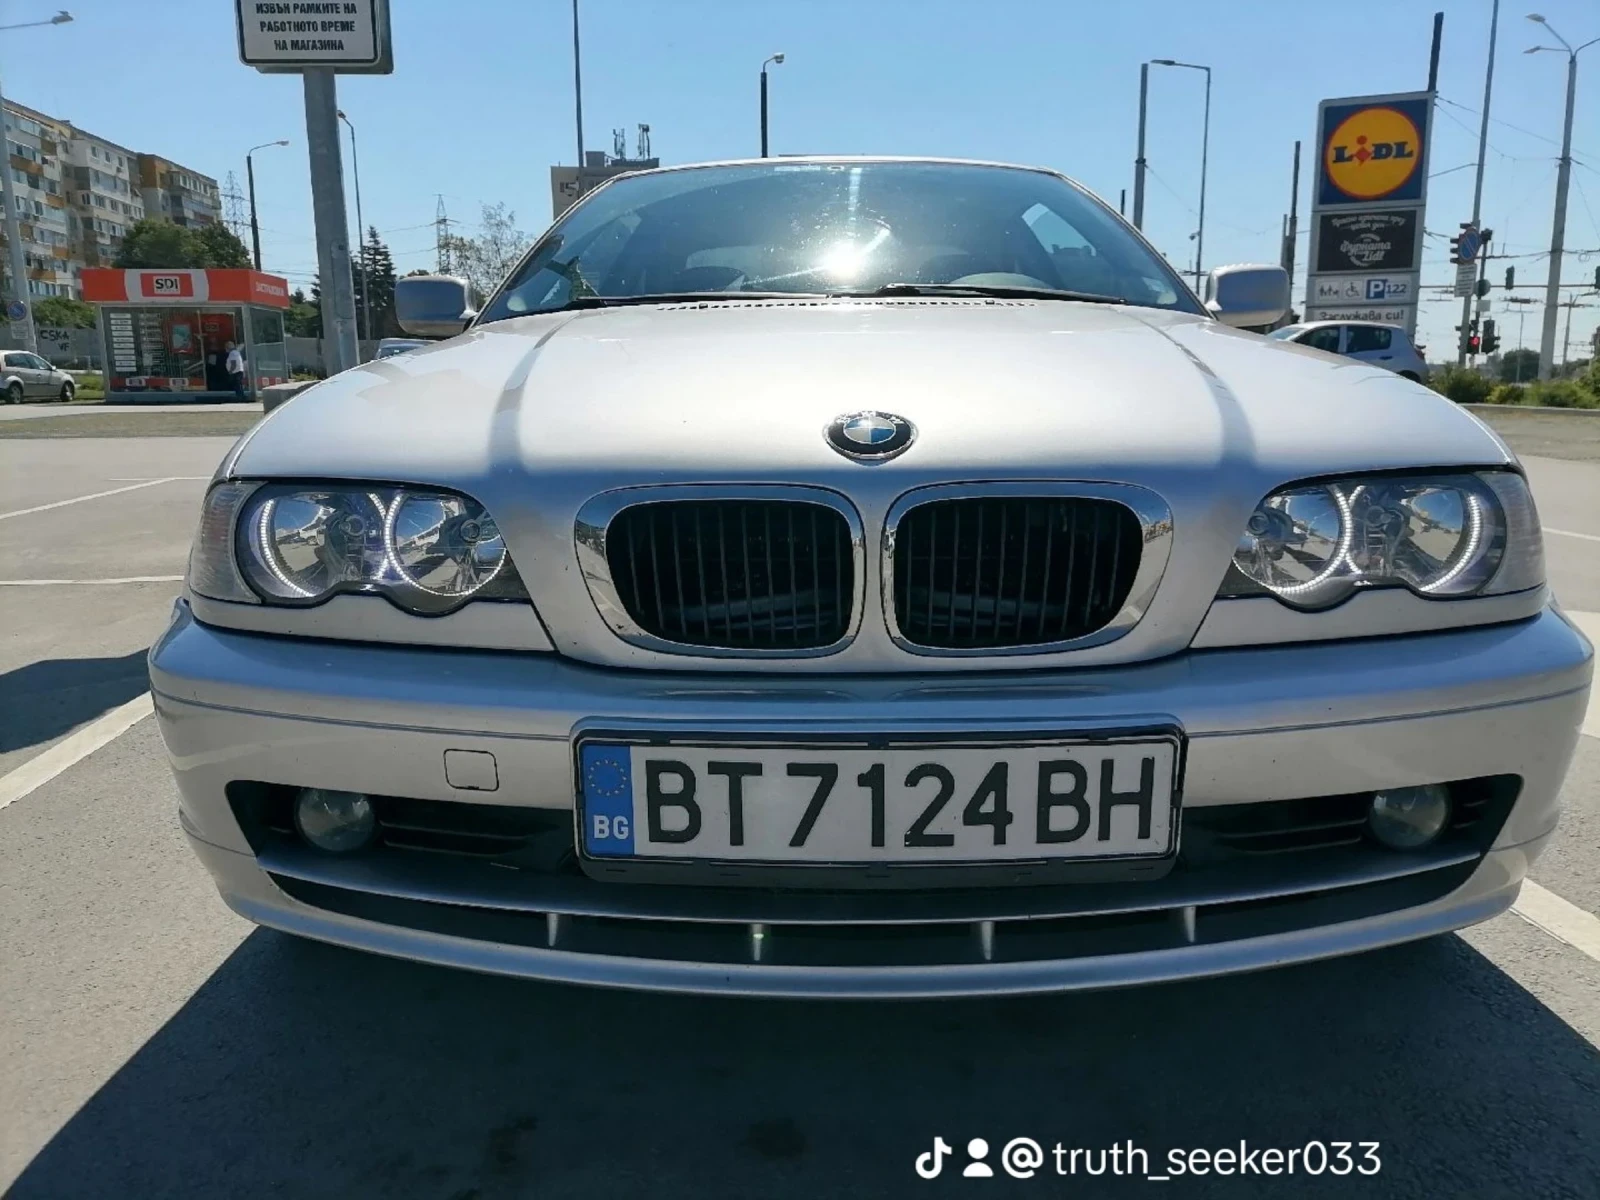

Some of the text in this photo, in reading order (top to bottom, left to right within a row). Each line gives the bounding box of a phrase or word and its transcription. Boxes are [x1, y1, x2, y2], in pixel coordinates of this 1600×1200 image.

[256, 3, 357, 14] ИЗВЪН РАМКИТЕ НА
[260, 21, 356, 32] РАБОТНОТО ВРЕМЕ
[274, 40, 344, 51] НА МАГАЗИНА
[1332, 135, 1414, 166] LIDL
[155, 278, 179, 290] SDI
[1386, 284, 1407, 294] 122
[40, 330, 69, 341] CSKA
[786, 761, 1014, 848] 7124
[593, 815, 629, 840] BG
